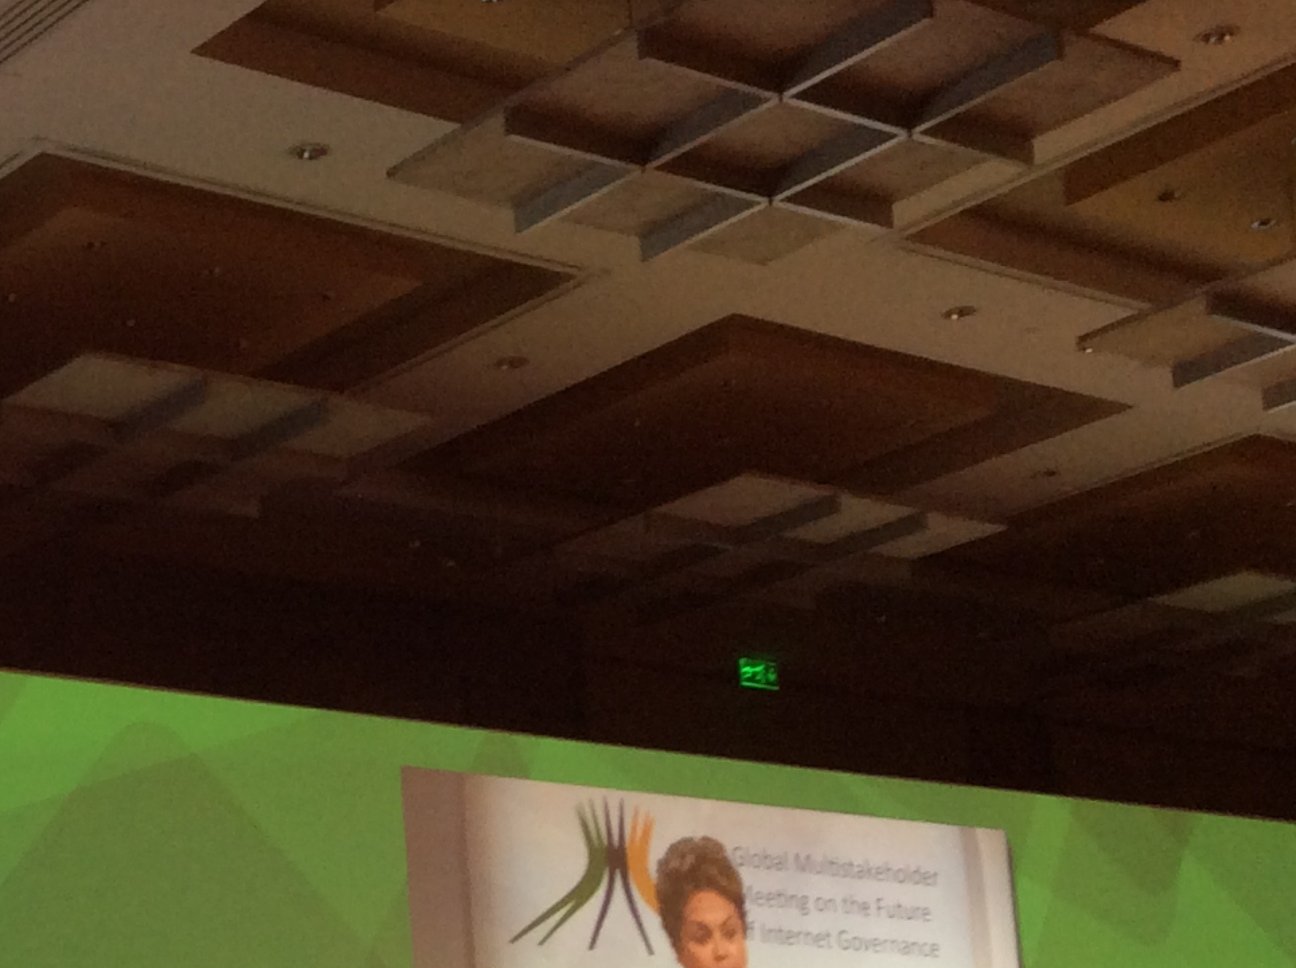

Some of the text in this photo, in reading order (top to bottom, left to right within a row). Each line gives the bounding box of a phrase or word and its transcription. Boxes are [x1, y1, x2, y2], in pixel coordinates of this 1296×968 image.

[732, 846, 789, 872] Global
[814, 896, 838, 912] on
[841, 896, 872, 917] the
[875, 898, 932, 922] Future
[760, 922, 834, 950] Internet
[836, 929, 941, 959] Governance
